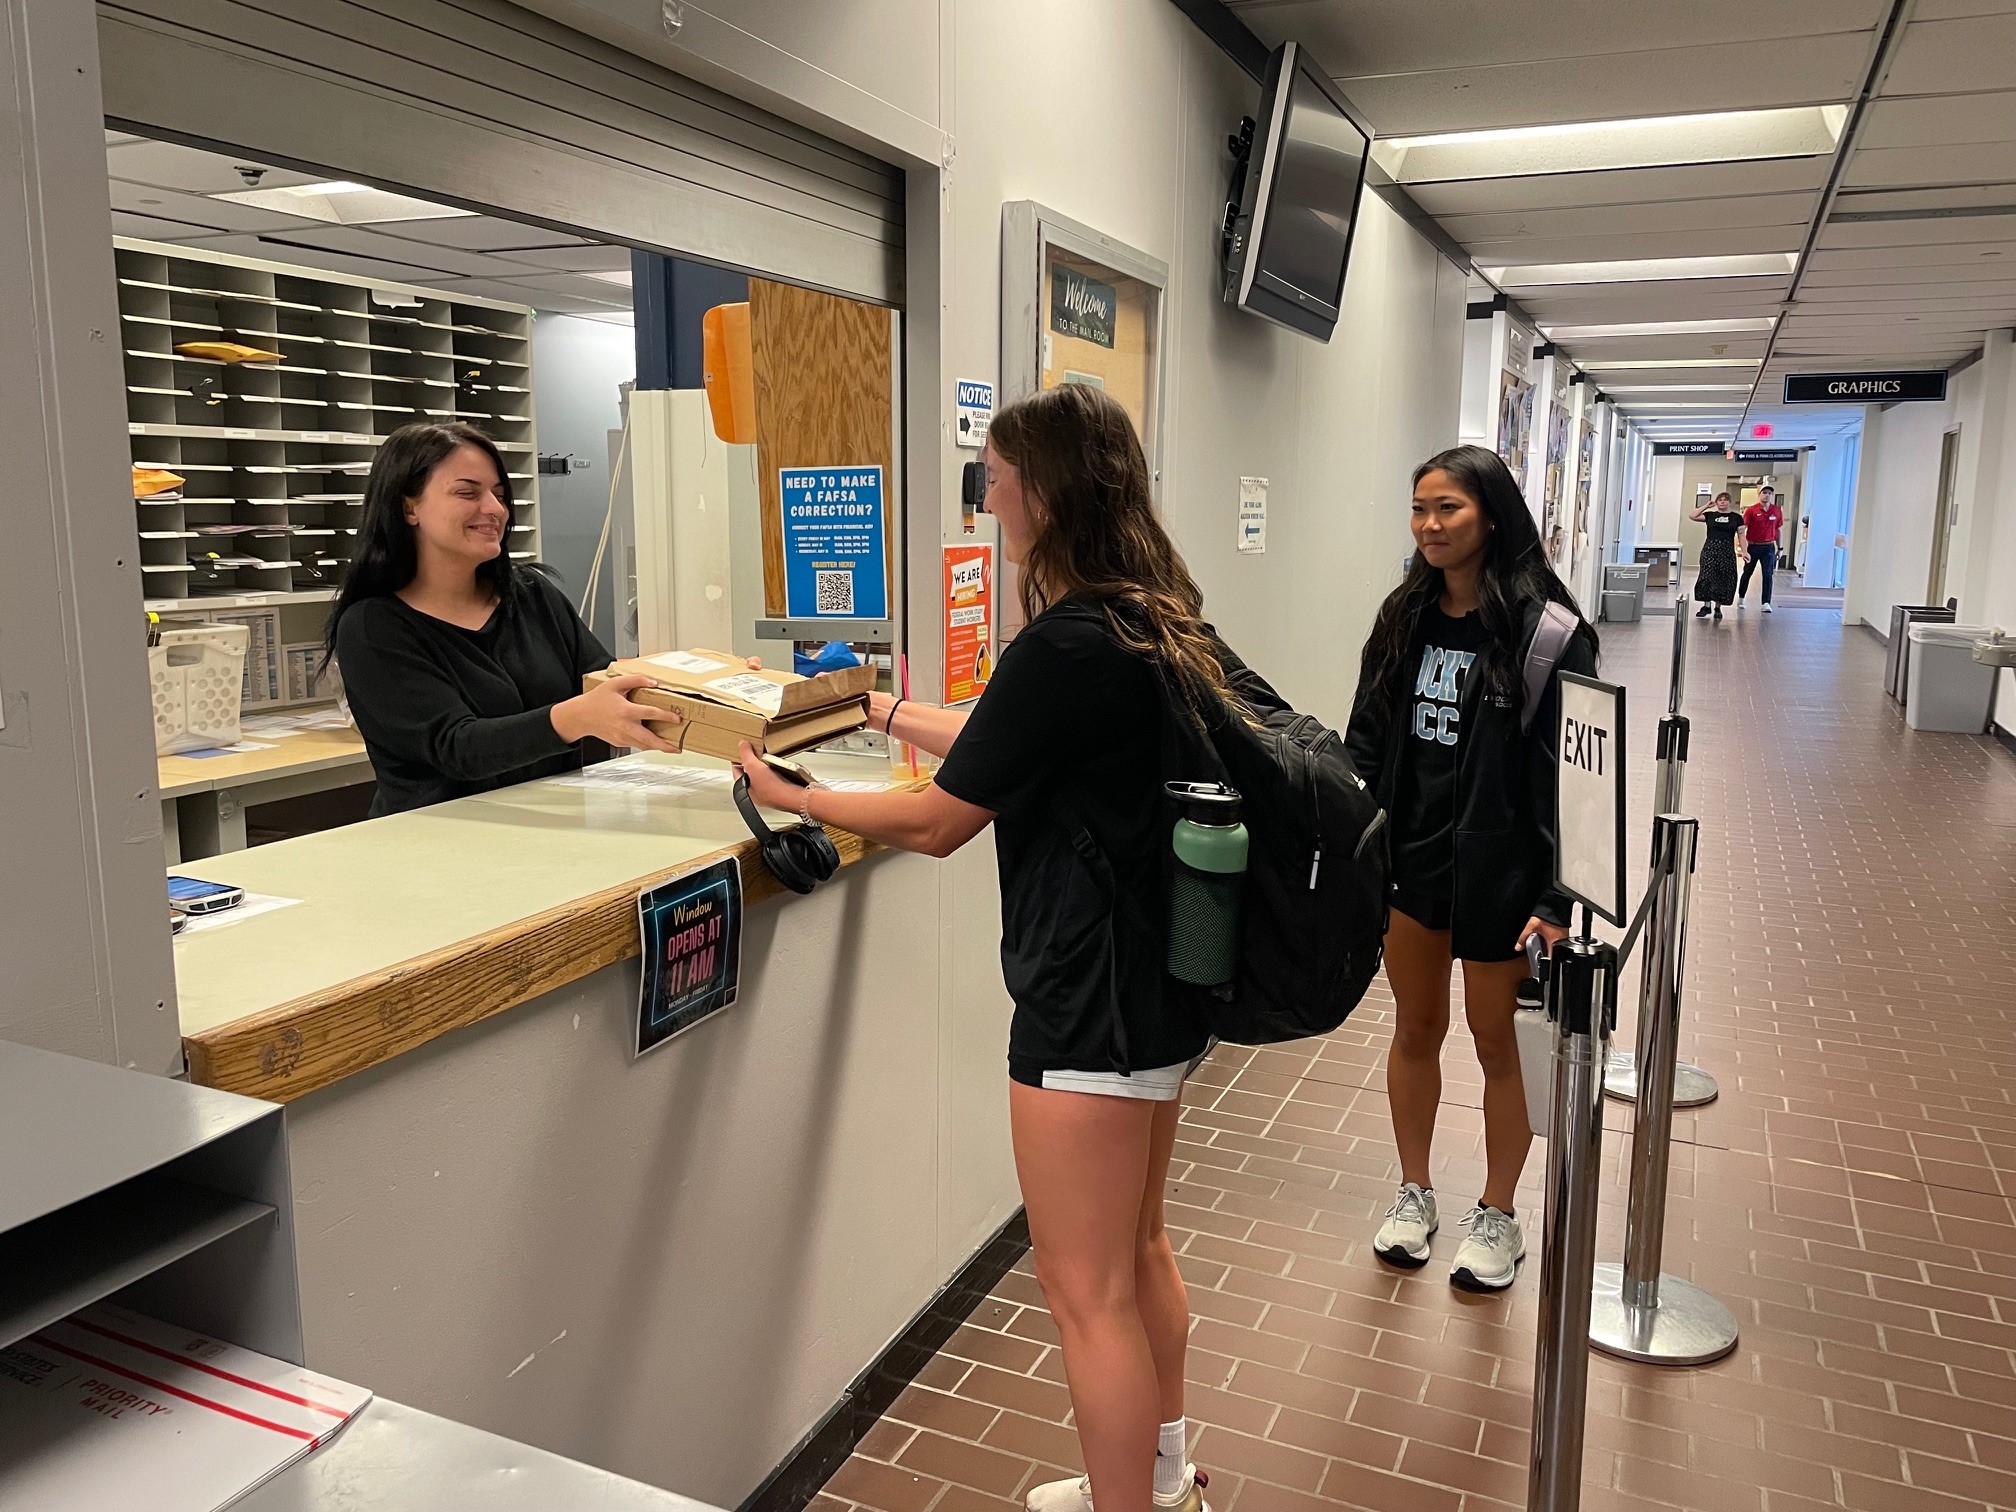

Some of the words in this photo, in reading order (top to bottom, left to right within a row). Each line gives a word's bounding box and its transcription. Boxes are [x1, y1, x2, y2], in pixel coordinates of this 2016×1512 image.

[1065, 274, 1107, 319] Welcome
[1059, 317, 1067, 330] TO
[1069, 321, 1078, 334] THE
[1080, 326, 1092, 339] MAIL
[1093, 329, 1109, 343] ROOM
[959, 385, 991, 407] NOTICE
[1828, 380, 1901, 395] GRAPHICS
[786, 477, 816, 489] NEED
[820, 476, 835, 488] TO
[841, 475, 876, 487] MAKE
[804, 491, 813, 502] A
[817, 490, 857, 502] FAFSA
[790, 504, 873, 517] CORRECTION?
[954, 572, 965, 585] WE
[967, 566, 980, 582] ARE
[957, 588, 976, 602] HIRING
[1564, 717, 1607, 776] EXIT
[673, 898, 713, 927] Window
[667, 923, 705, 961] OPENS
[708, 914, 722, 943] AT
[670, 960, 683, 997] 11
[686, 945, 716, 988] AM
[668, 994, 689, 1009] MONDAY
[692, 984, 709, 996] FRIDAY
[79, 1379, 167, 1415] PRIORITY
[80, 1397, 124, 1419] MAIL
